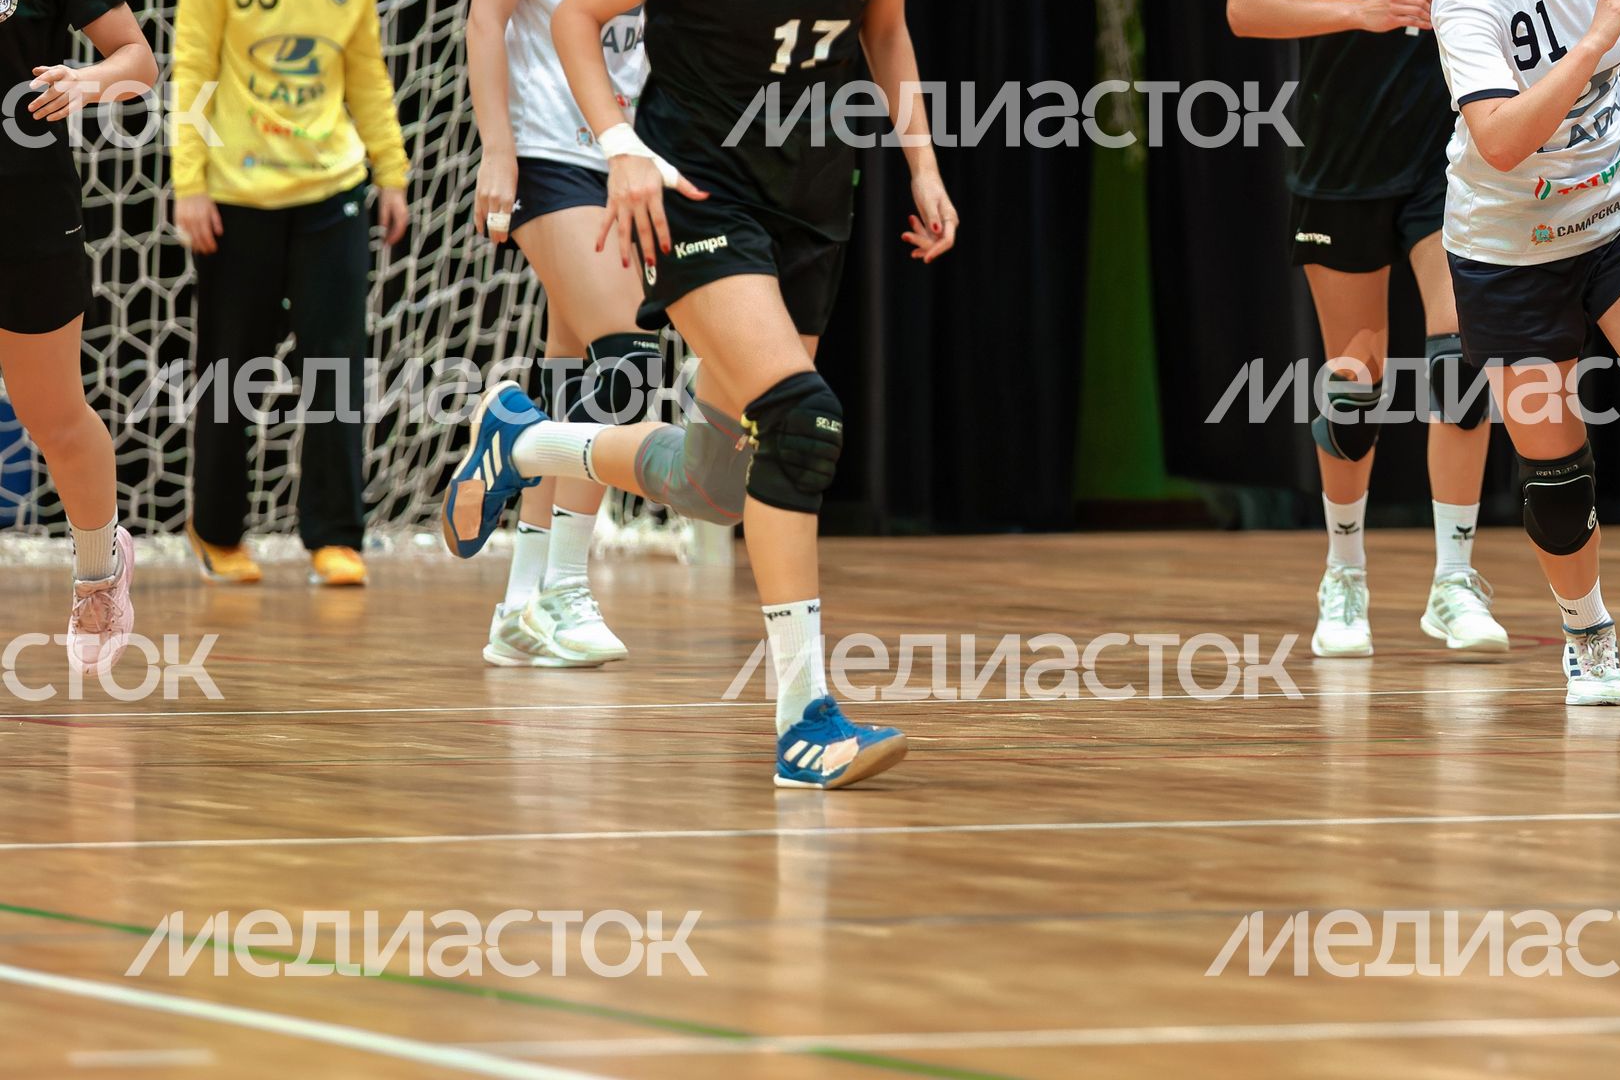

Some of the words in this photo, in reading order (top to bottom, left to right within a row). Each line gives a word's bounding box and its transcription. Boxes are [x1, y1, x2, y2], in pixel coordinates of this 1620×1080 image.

[769, 19, 851, 75] 17
[1510, 0, 1568, 71] 91
[1536, 100, 1620, 154] ADA
[674, 235, 728, 259] Kempa
